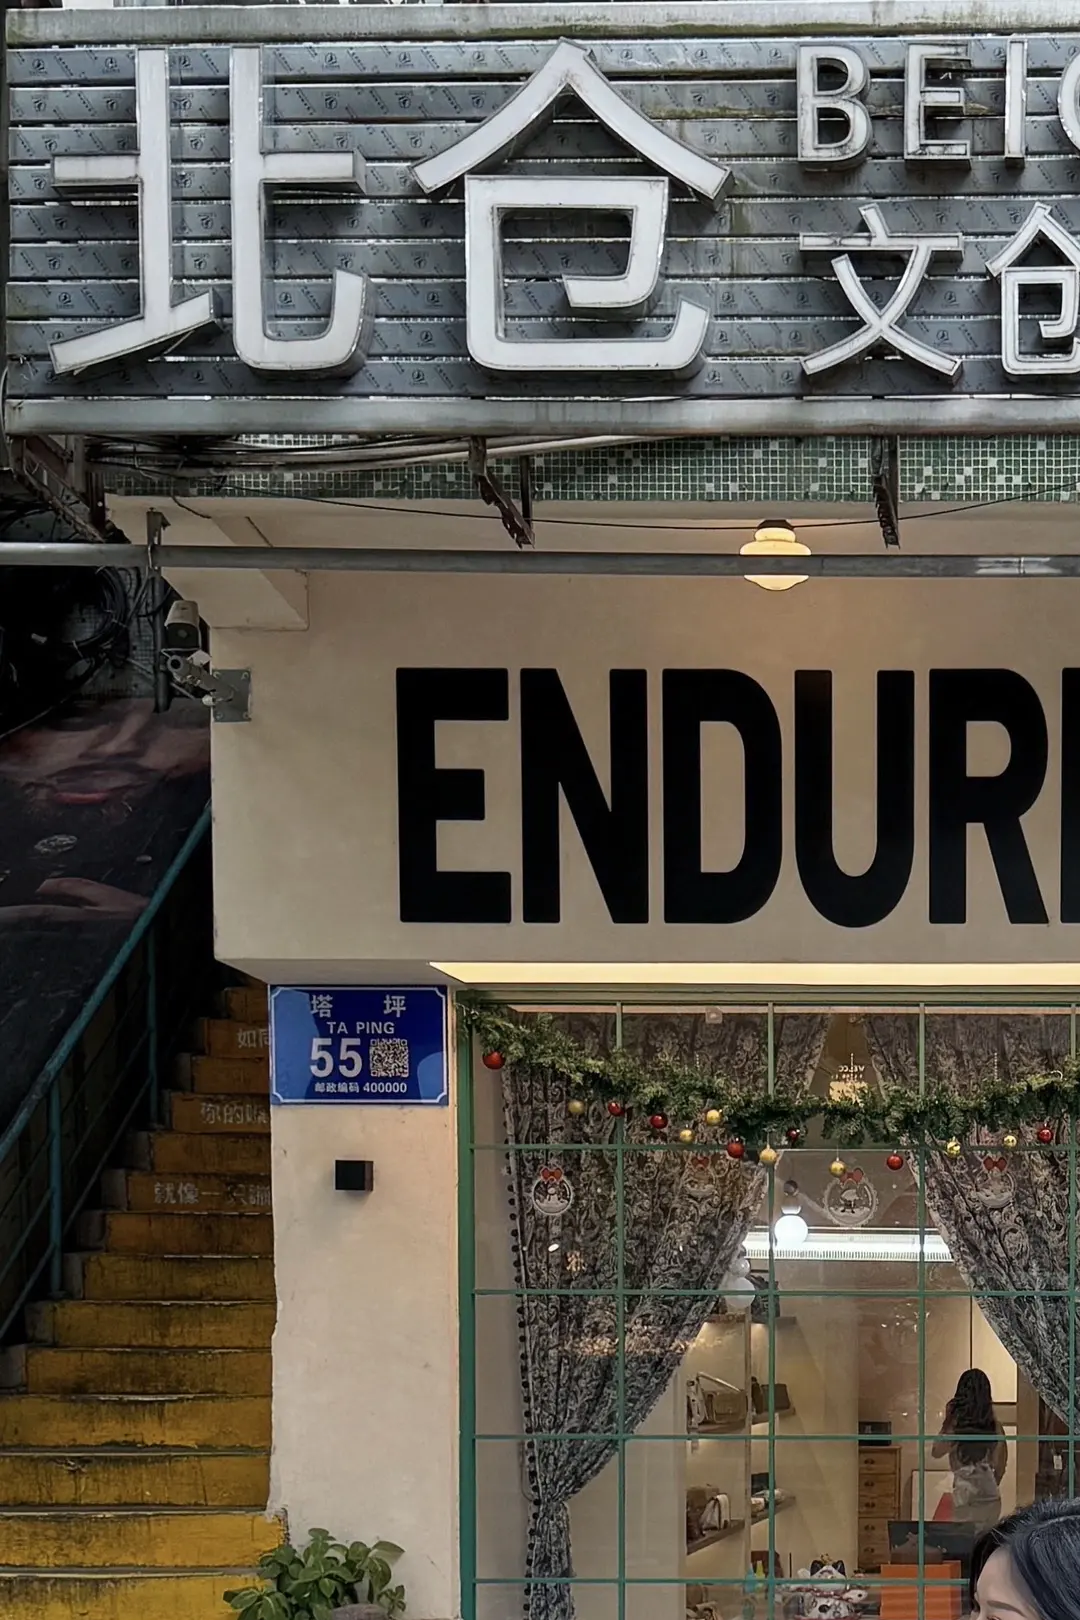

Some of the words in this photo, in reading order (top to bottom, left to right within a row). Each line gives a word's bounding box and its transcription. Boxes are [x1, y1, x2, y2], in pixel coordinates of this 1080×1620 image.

[49, 36, 733, 377] 北仓
[326, 1022, 348, 1034] TA
[356, 1021, 395, 1034] PING
[310, 1037, 363, 1078] 55
[363, 1082, 407, 1093] 400000
